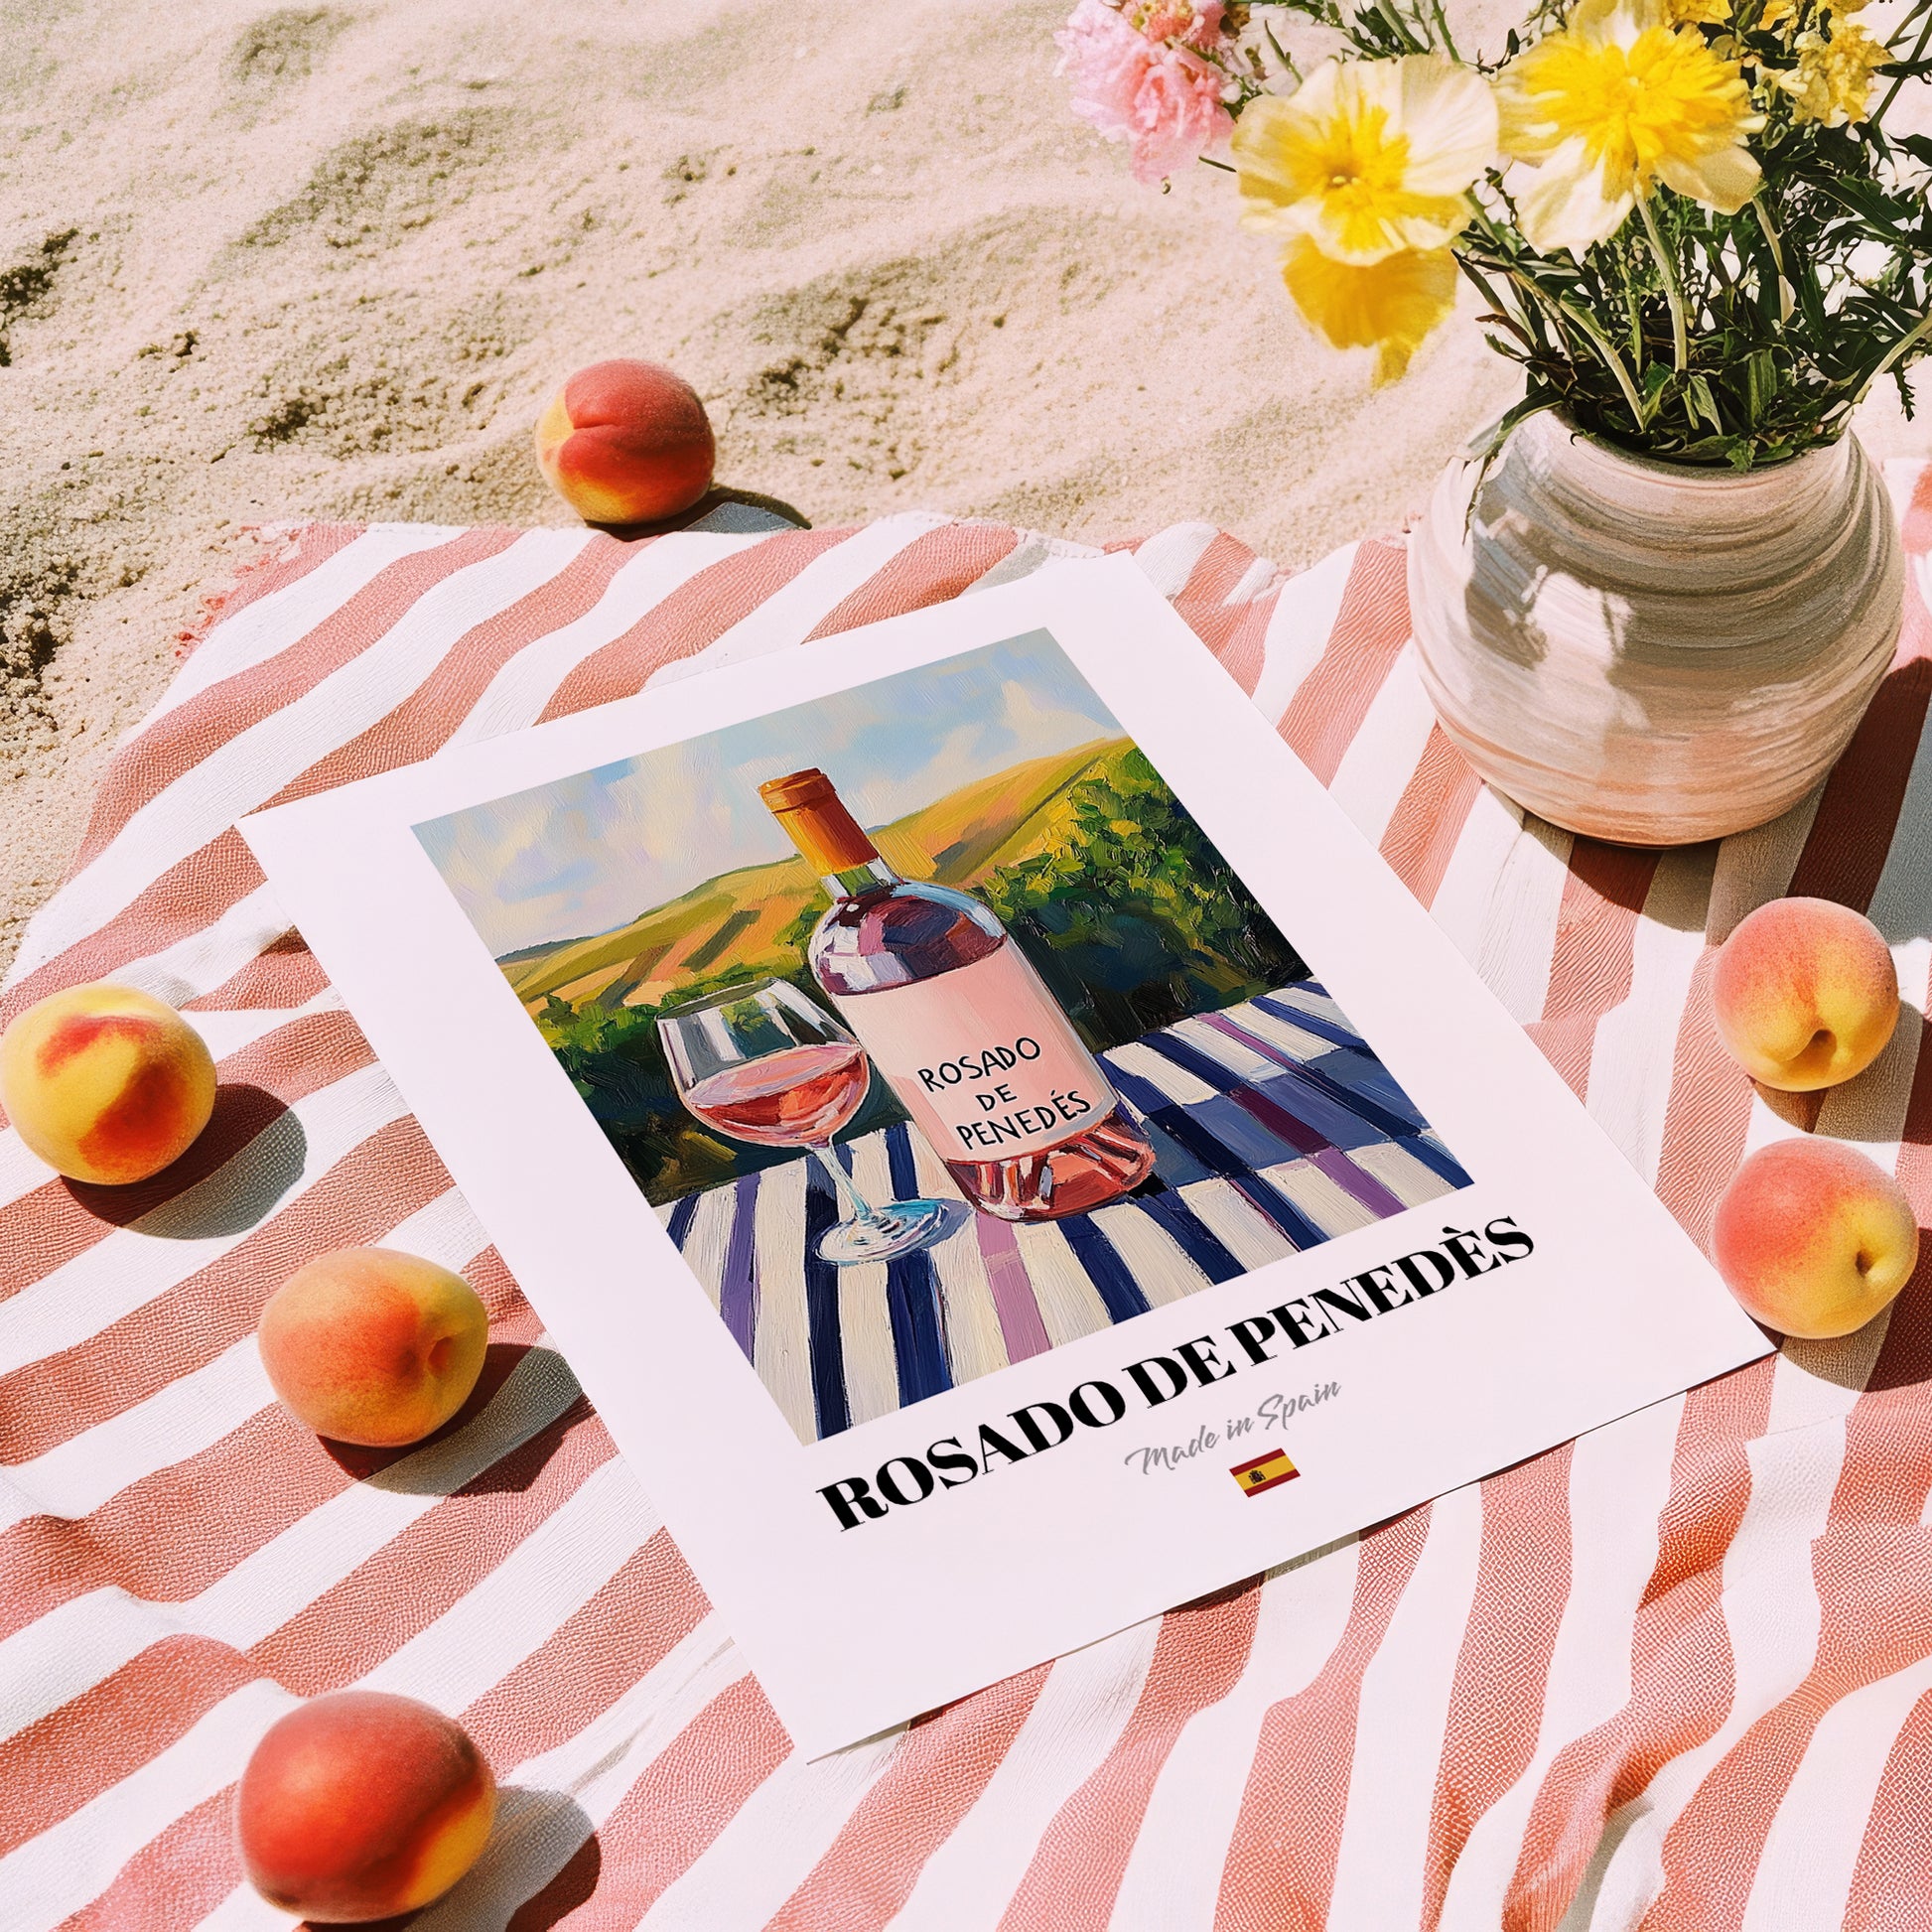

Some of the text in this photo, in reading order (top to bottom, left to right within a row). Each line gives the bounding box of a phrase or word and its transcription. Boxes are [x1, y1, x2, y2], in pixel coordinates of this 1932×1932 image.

[917, 1036, 1040, 1093] ROSADO
[955, 1089, 1091, 1151] PENEDÉS
[975, 1083, 1018, 1112] DE
[816, 1215, 1536, 1533] ROSADO DE PENEDÈS
[1124, 1381, 1341, 1475] Made in Spain
